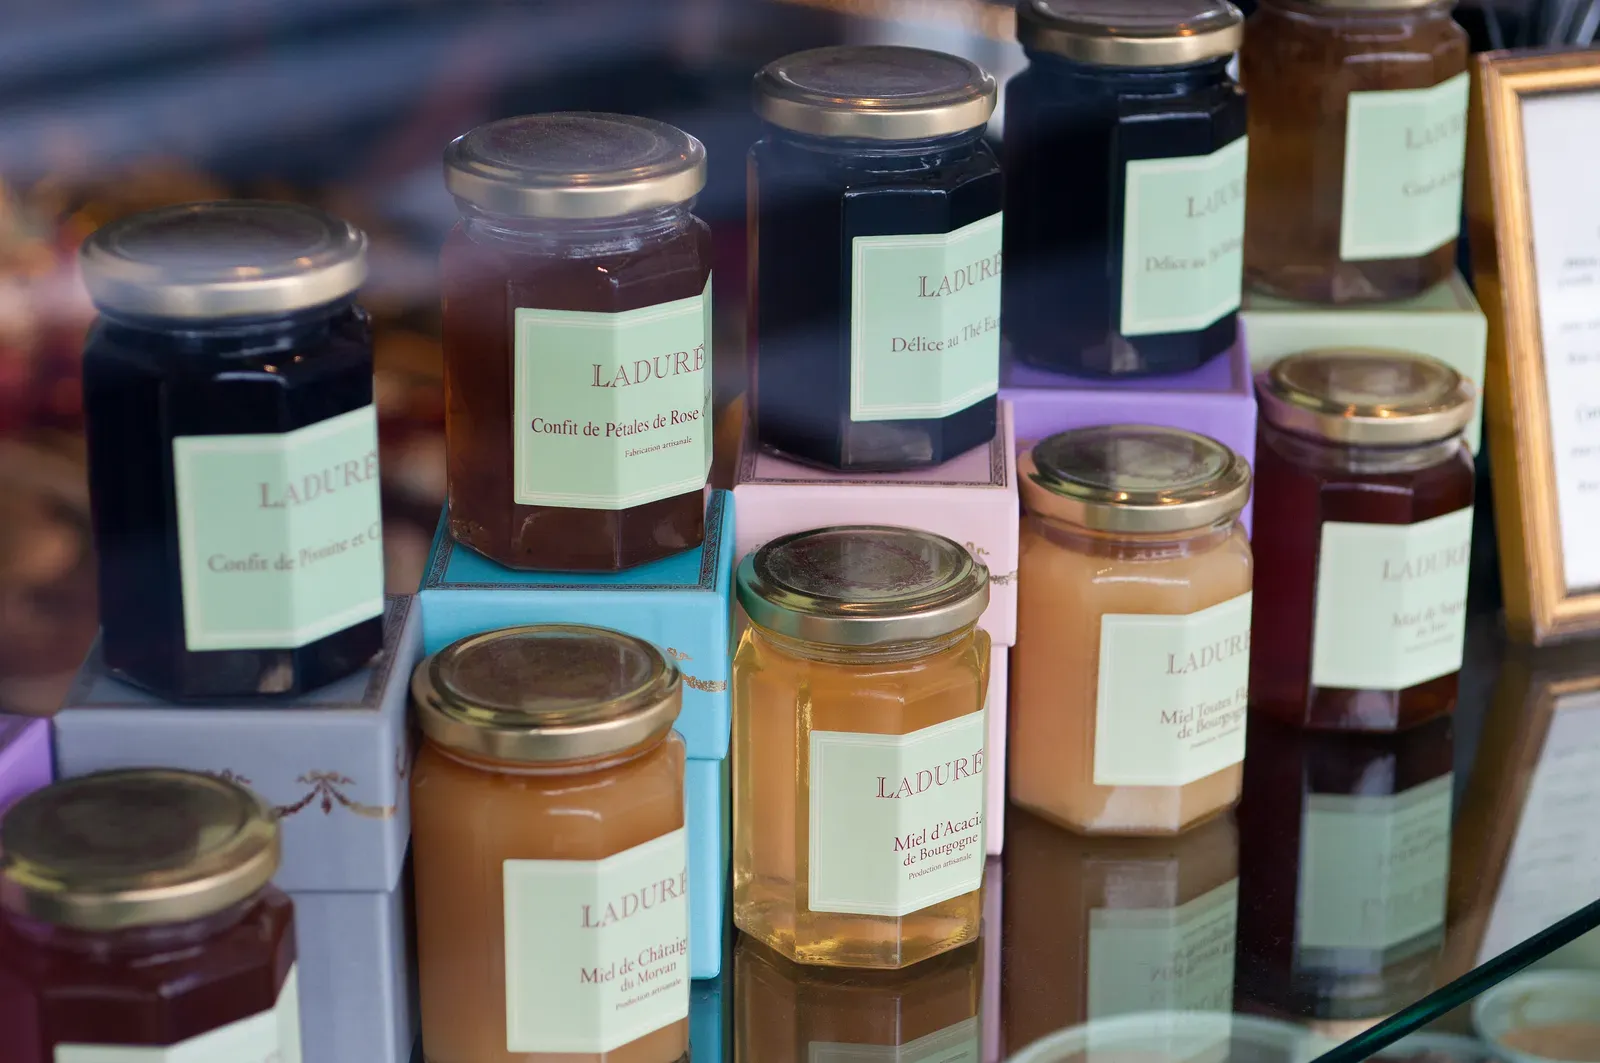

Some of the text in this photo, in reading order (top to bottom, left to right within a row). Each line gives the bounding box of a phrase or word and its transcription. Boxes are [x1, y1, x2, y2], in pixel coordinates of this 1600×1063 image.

[891, 336, 944, 353] Délice
[947, 336, 959, 348] au
[962, 321, 982, 341] Thé
[591, 344, 706, 388] LADURÉ
[531, 409, 699, 437] Confit de Pétales de Rose
[624, 436, 693, 458] Fabrication artisanale
[208, 553, 268, 573] Confit
[273, 551, 295, 571] de
[1160, 706, 1194, 724] Miel
[1177, 724, 1192, 739] de
[876, 748, 983, 799] LADURÉ
[893, 828, 926, 852] Miel
[903, 834, 978, 867] de Bourgogne
[908, 852, 972, 880] Production artisanale
[580, 962, 615, 984] Miel
[619, 956, 635, 976] de
[620, 961, 677, 992] du Morvan
